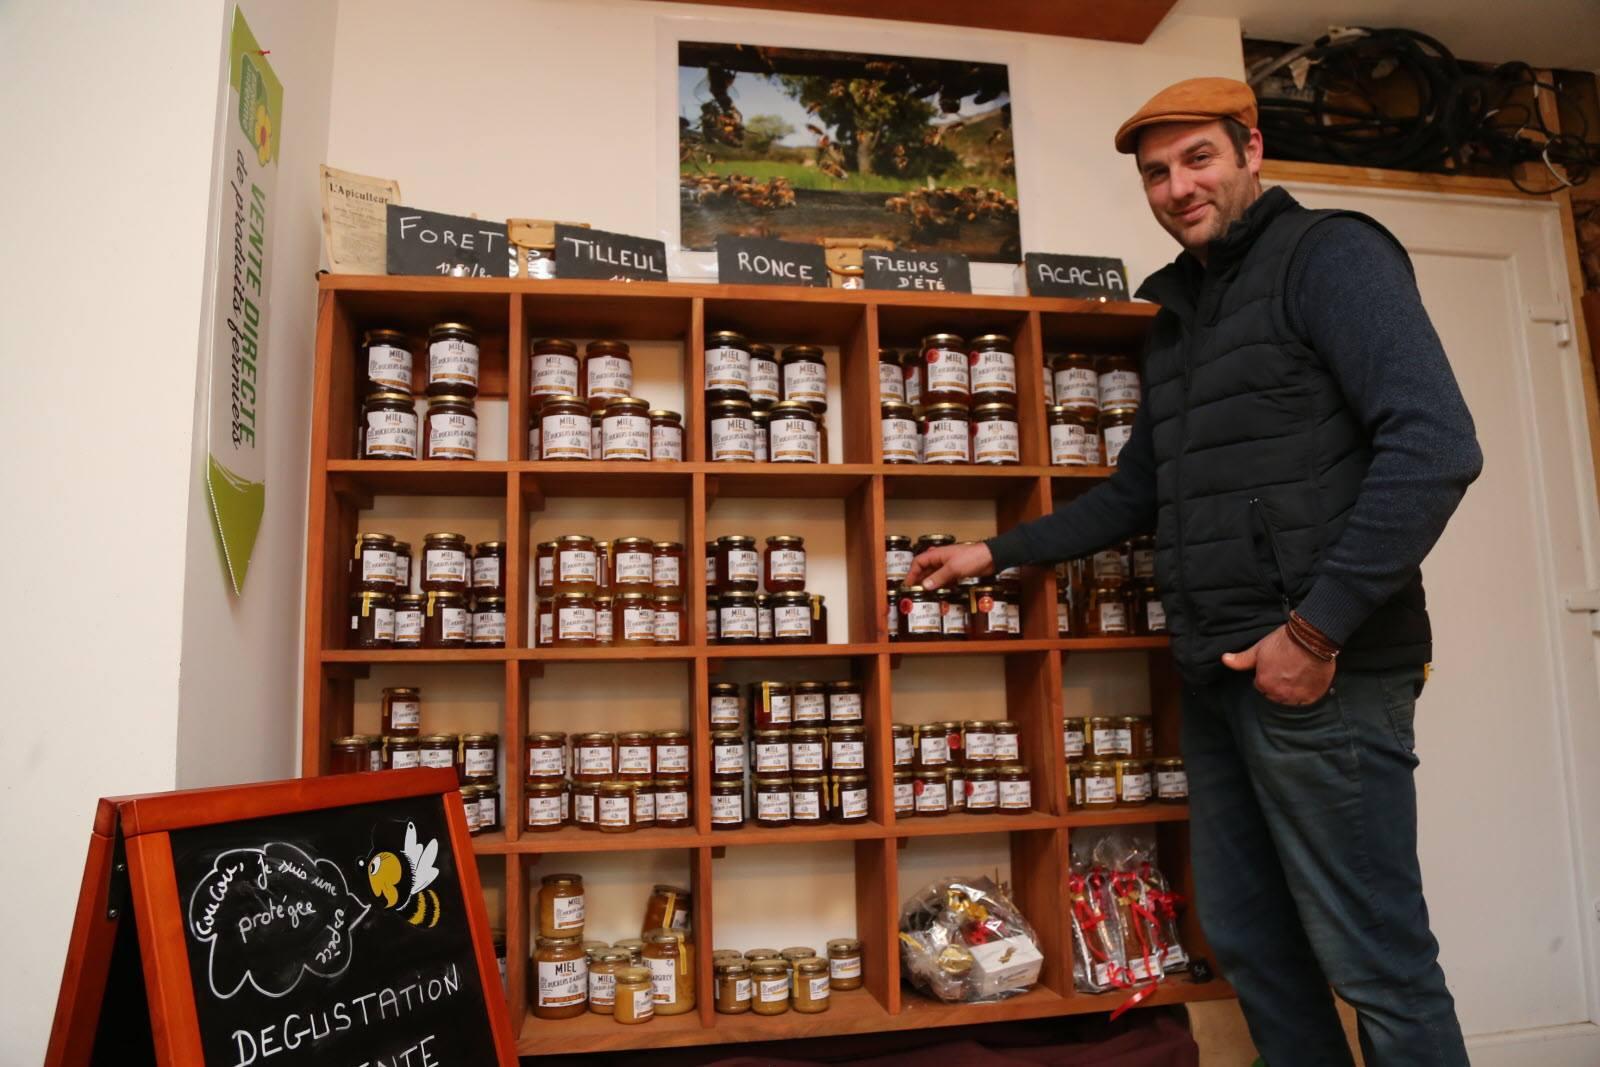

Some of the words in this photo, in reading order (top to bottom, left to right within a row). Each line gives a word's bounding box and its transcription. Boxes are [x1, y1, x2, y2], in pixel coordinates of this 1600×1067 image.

[235, 149, 249, 185] de
[246, 183, 266, 298] VENTE
[400, 215, 504, 253] FORET
[230, 181, 246, 316] produits
[737, 252, 813, 279] RONCE
[869, 255, 938, 273] FLEURS
[449, 343, 465, 352] MIEL
[720, 350, 740, 361] MIEL
[239, 296, 260, 449] DIRECTE
[799, 364, 818, 375] MIEL
[227, 317, 245, 450] fermiers
[385, 414, 402, 423] MIEL
[449, 417, 466, 426] MIEL
[560, 416, 576, 426] MIEL
[617, 417, 633, 427] MIEL
[728, 419, 748, 431] MIEL
[786, 421, 806, 432] MIEL
[311, 877, 337, 896] une
[555, 961, 577, 975] MIEL
